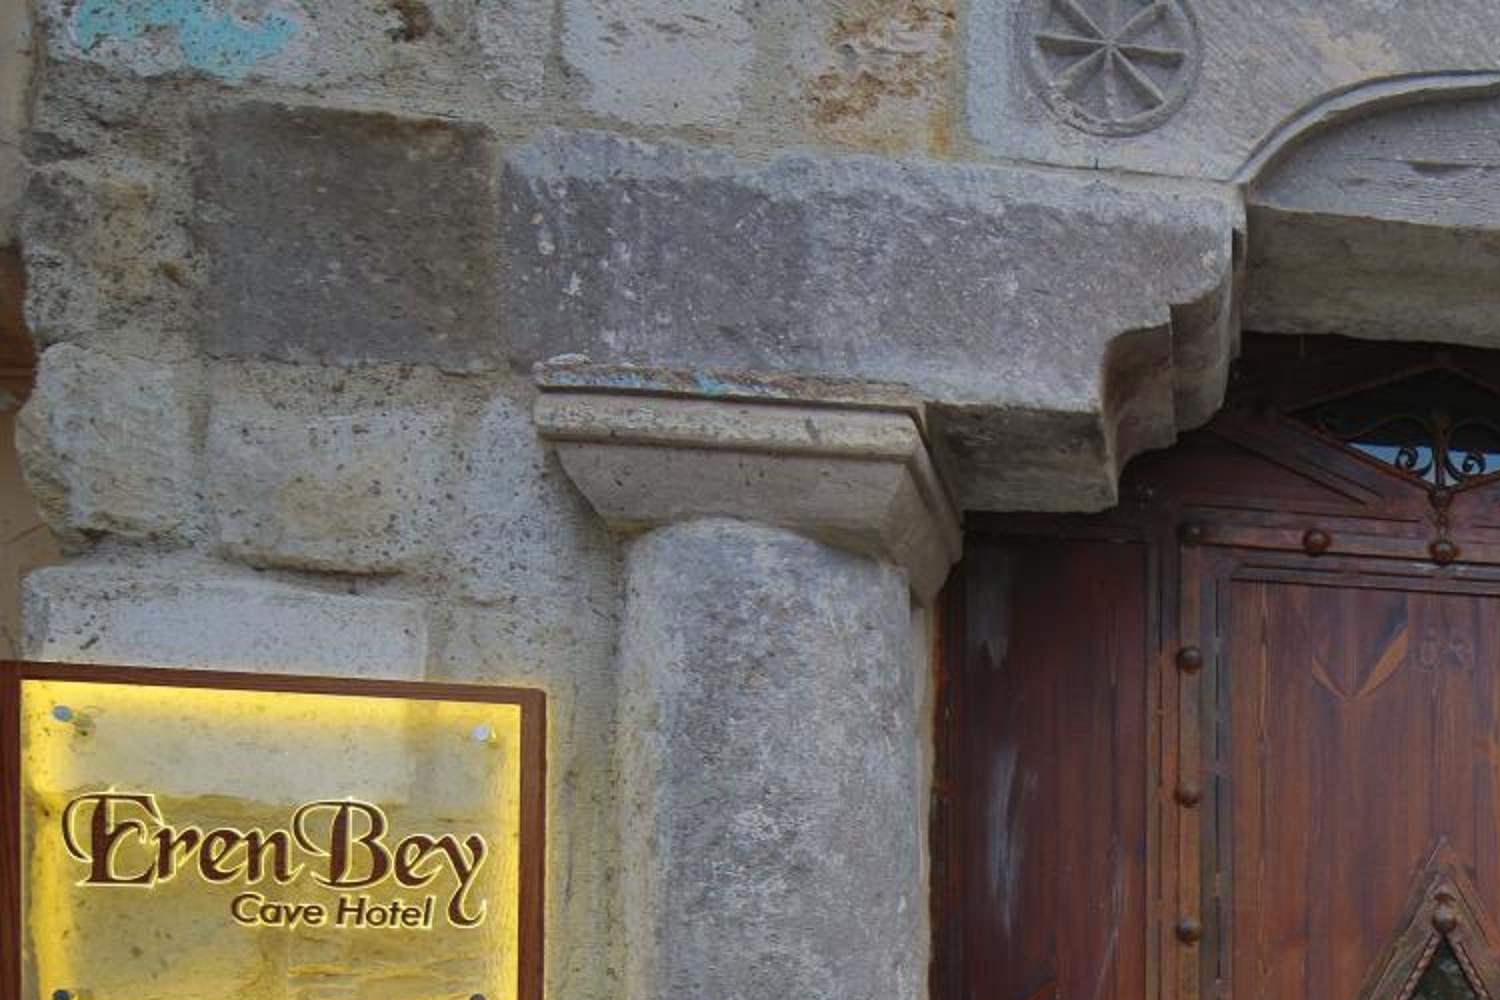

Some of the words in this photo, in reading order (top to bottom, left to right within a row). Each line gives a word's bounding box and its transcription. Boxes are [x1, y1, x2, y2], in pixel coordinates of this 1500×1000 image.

[62, 792, 302, 887] Eren
[292, 797, 488, 927] Bey
[231, 893, 324, 927] Cave
[336, 896, 434, 928] Hotel
